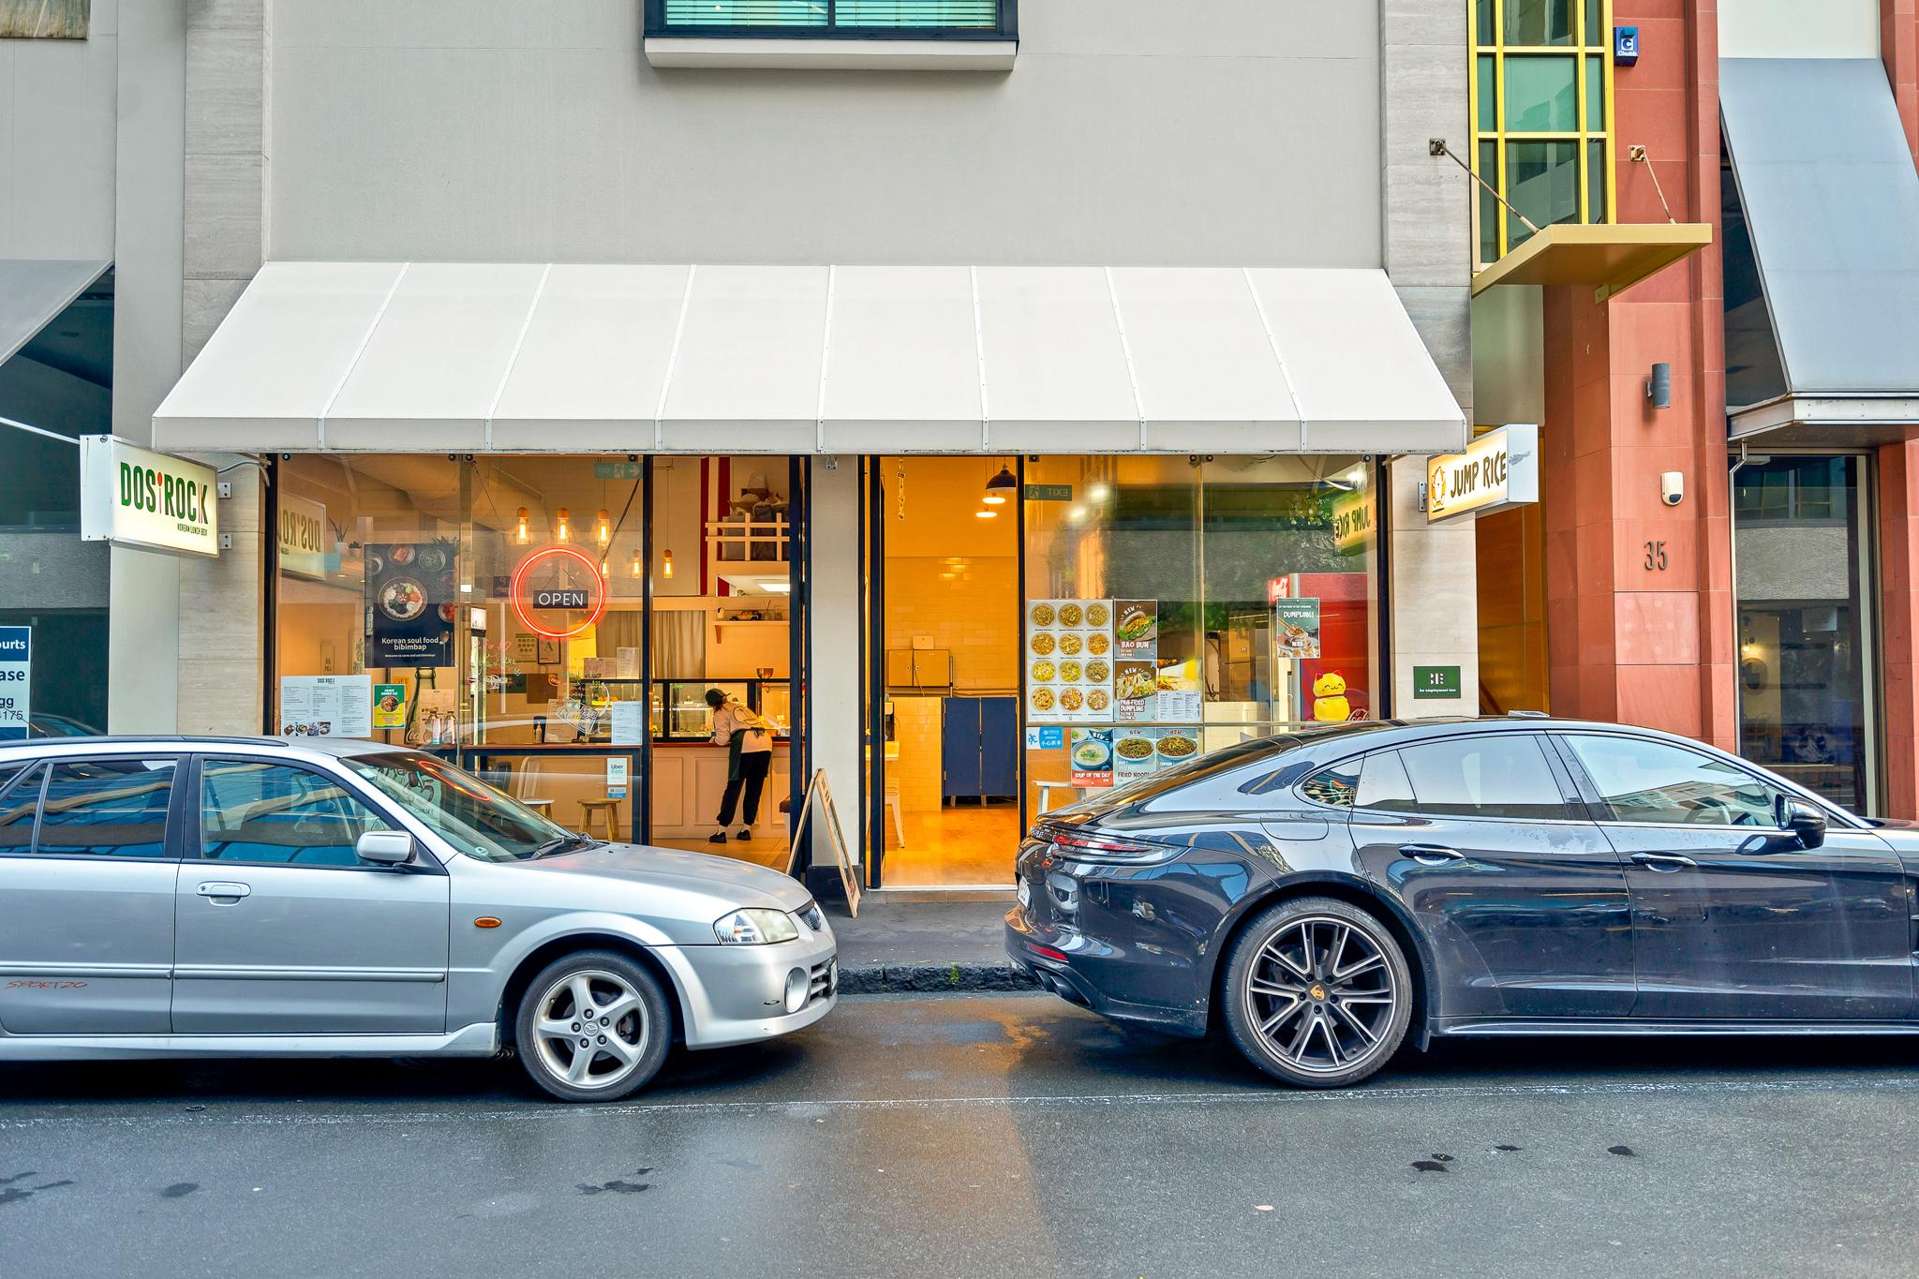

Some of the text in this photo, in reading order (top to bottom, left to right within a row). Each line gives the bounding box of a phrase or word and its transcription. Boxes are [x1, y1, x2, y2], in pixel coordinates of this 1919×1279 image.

[1450, 450, 1507, 498] JUMP RICE
[1643, 540, 1669, 571] 35
[538, 593, 584, 606] OPEN
[0, 639, 26, 650] urts
[382, 637, 406, 645] Korean
